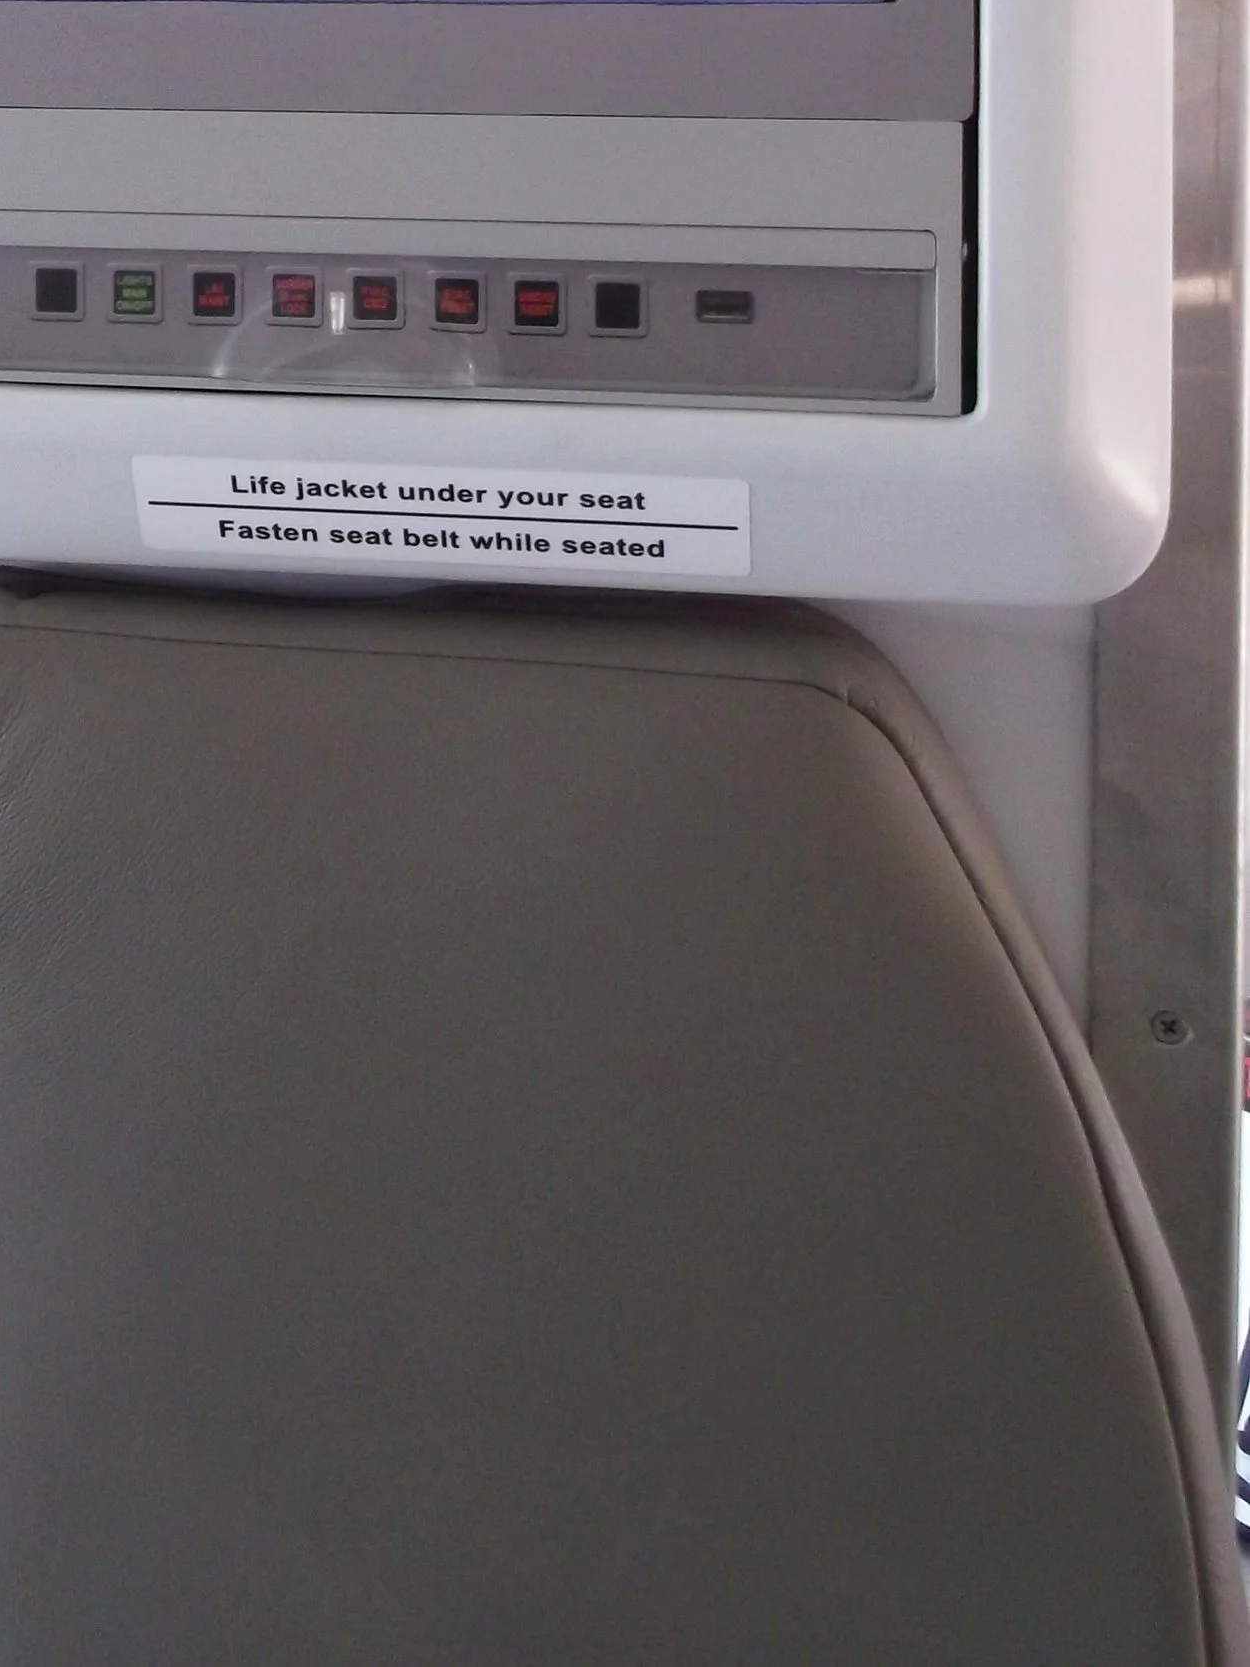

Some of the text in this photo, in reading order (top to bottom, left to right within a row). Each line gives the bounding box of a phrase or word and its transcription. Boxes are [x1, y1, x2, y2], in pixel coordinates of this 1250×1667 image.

[230, 474, 646, 511] Life jacket under your seat
[218, 519, 665, 558] Fasten seat belt while seated
